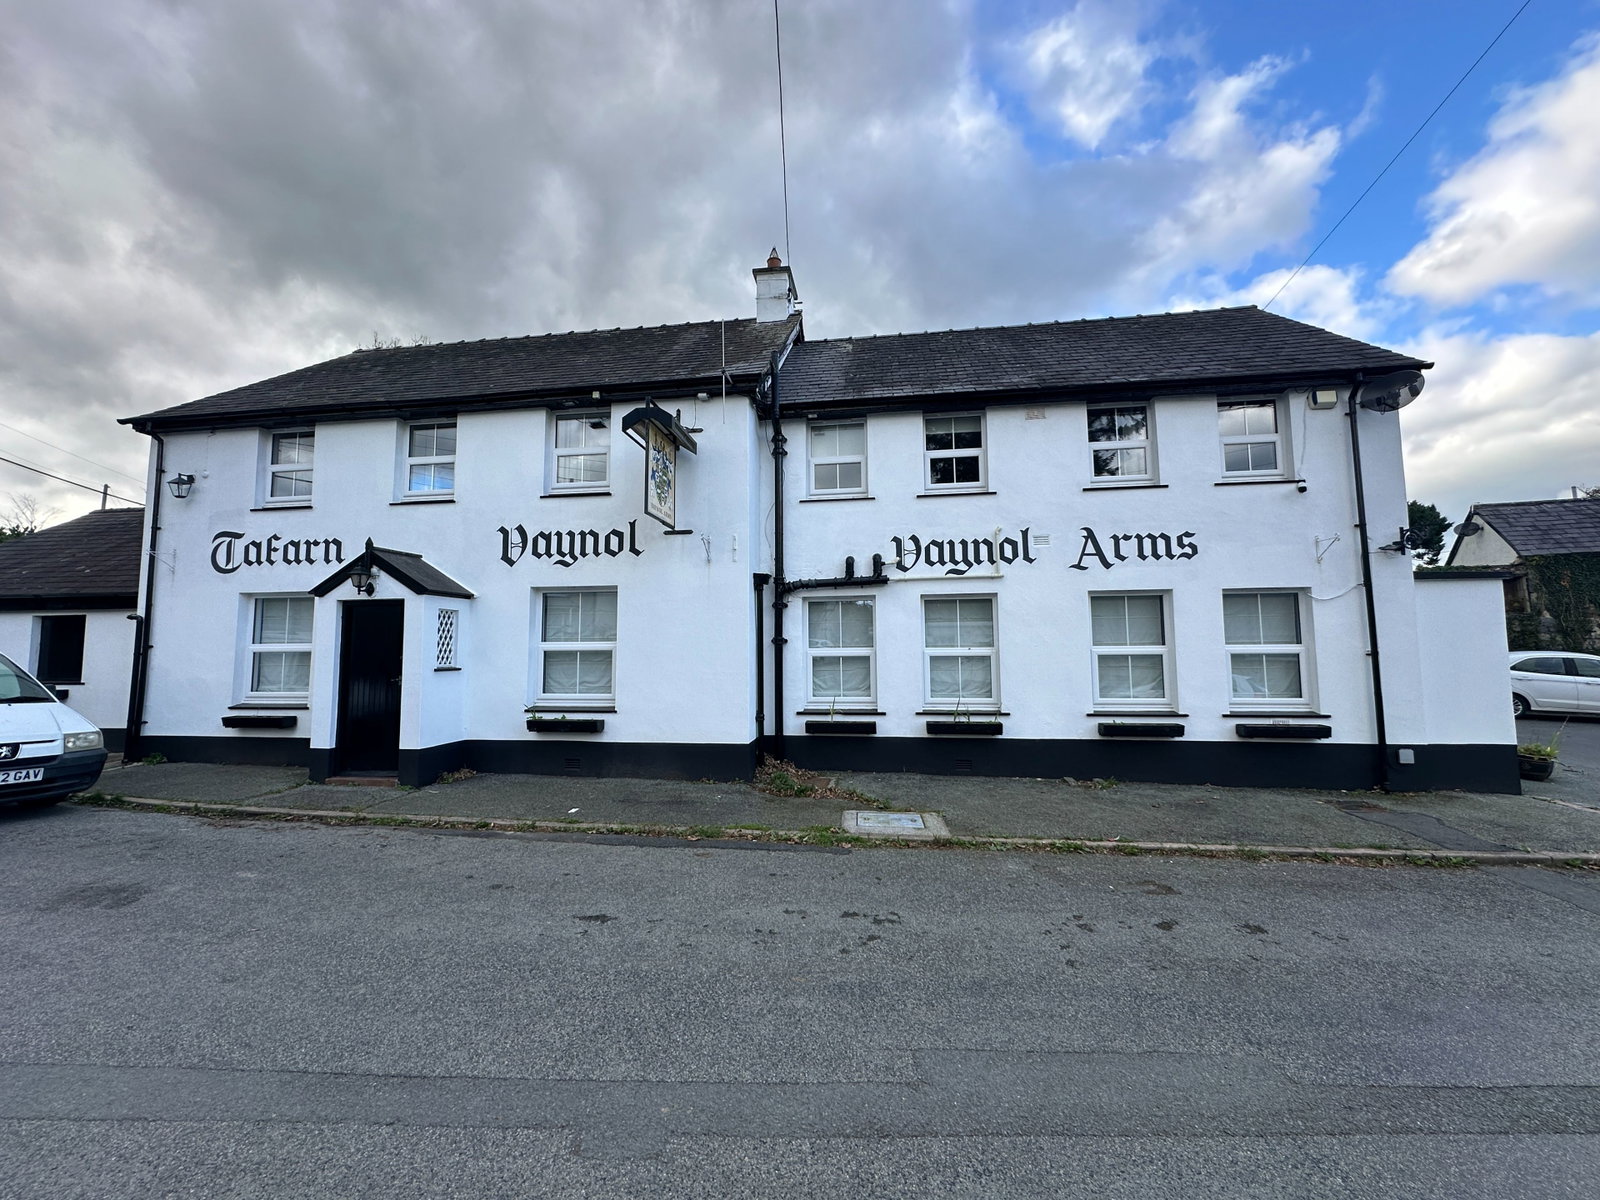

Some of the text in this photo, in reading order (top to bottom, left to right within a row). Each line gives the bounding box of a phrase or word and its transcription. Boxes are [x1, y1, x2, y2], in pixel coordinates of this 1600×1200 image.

[210, 530, 346, 575] Tafarn
[497, 518, 645, 568] Vaynol
[890, 526, 1199, 576] Vaynol Arms
[13, 769, 41, 781] GAV
